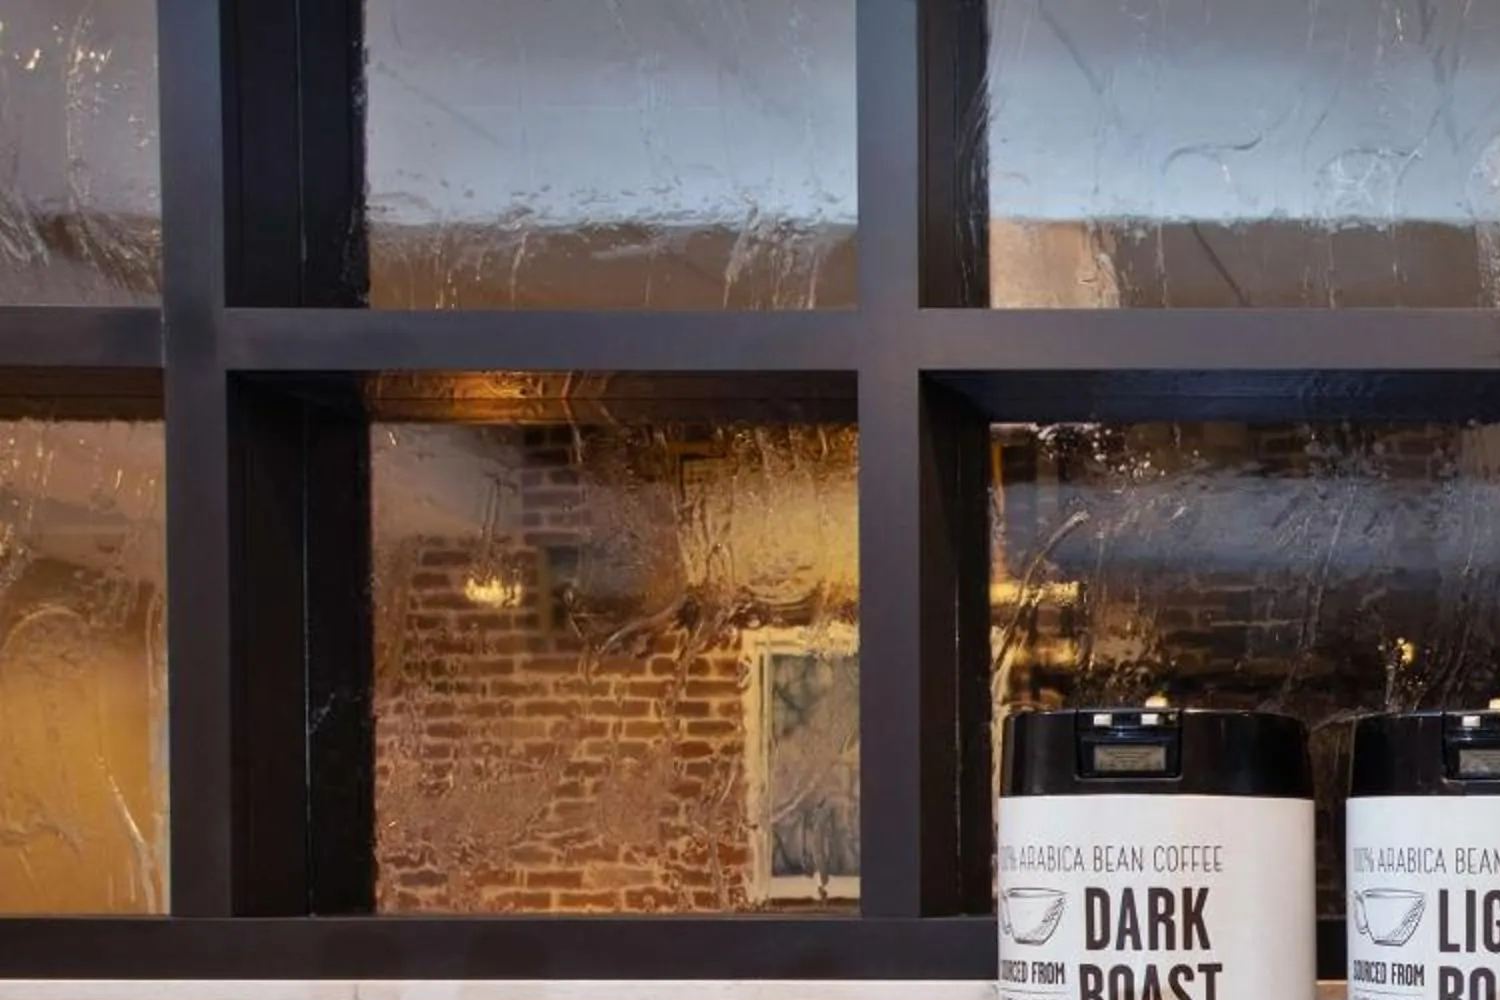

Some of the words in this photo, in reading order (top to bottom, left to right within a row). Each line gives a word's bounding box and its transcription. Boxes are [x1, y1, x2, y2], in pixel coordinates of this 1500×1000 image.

[1019, 845, 1085, 872] ARABICA
[1093, 845, 1143, 873] BEAN
[1153, 845, 1224, 873] COFFEE
[1377, 847, 1446, 875] ARABICA
[1085, 886, 1210, 951] DARK
[1032, 961, 1065, 985] FROM
[1391, 963, 1425, 987] FROM
